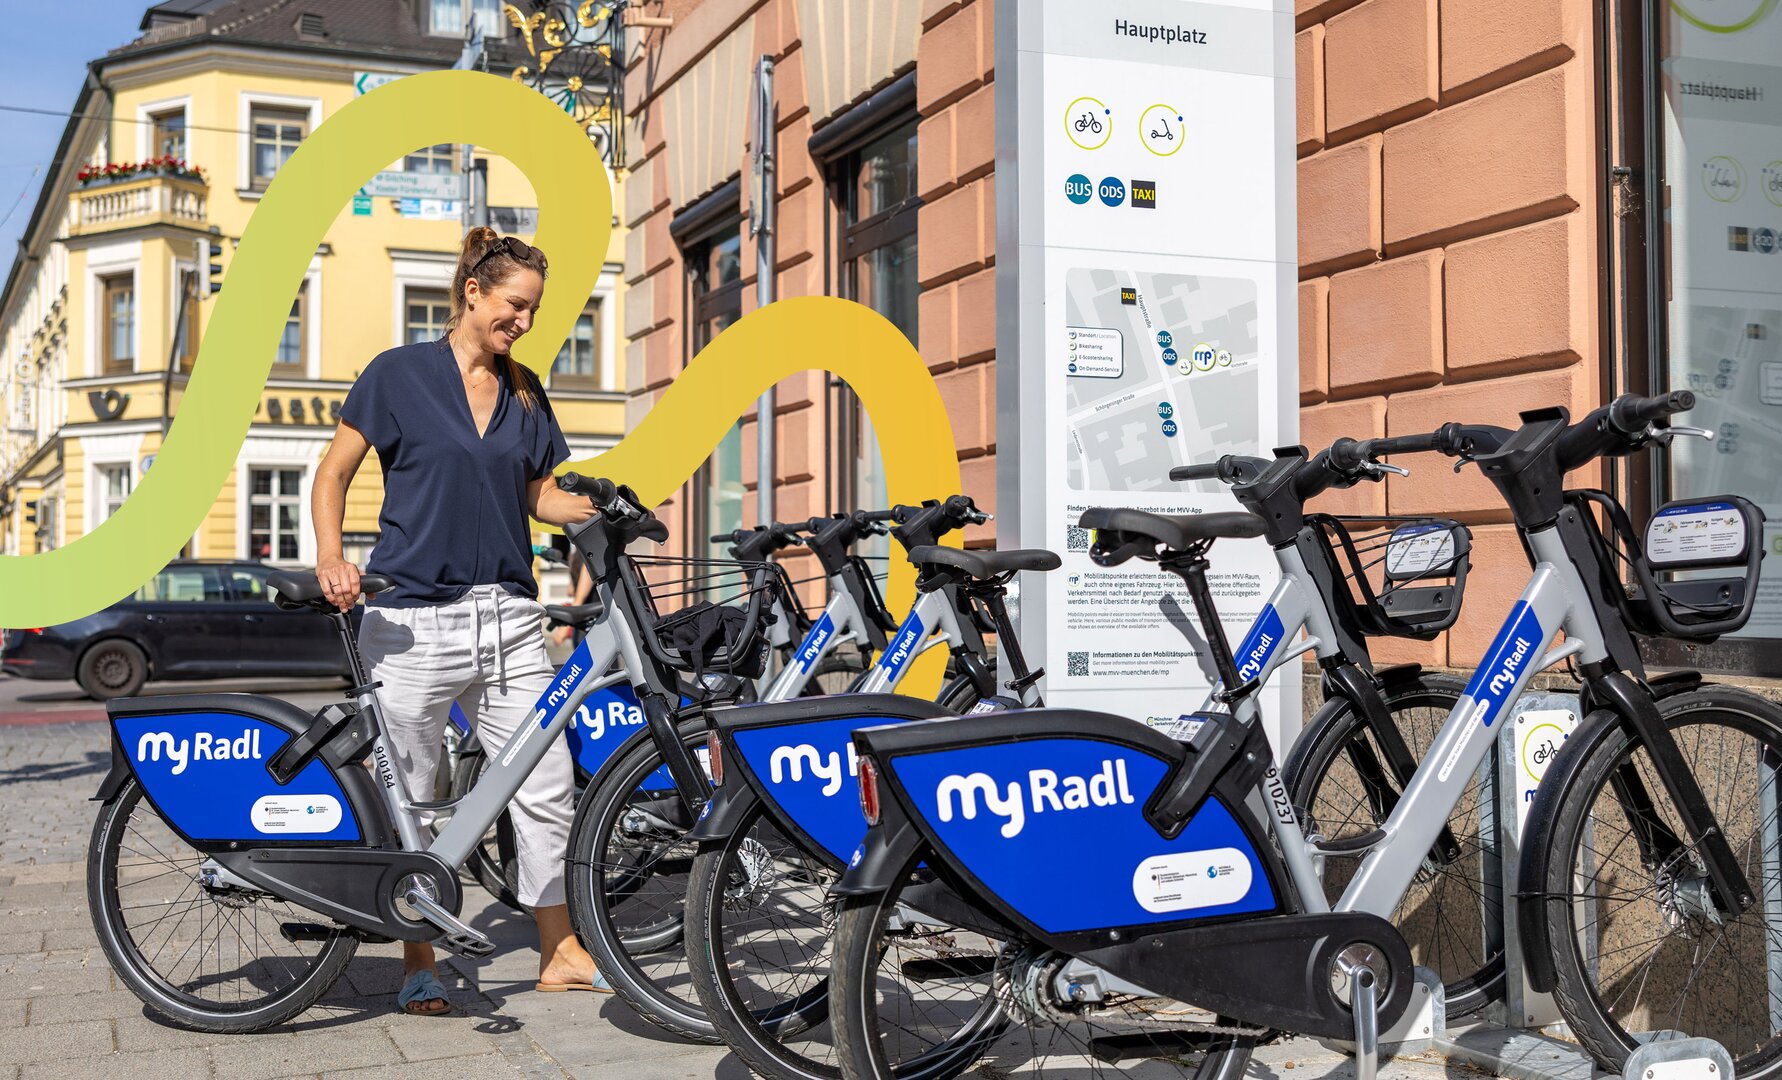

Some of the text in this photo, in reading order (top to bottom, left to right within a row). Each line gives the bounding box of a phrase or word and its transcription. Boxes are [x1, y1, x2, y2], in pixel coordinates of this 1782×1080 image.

[1115, 19, 1207, 45] Hauptplatz
[1065, 182, 1154, 201] BUS ODS TAXI
[1122, 292, 1135, 300] TAXI
[1138, 294, 1151, 328] Hauptstraße
[1157, 335, 1171, 343] BUS
[1158, 406, 1172, 414] BUS
[375, 746, 395, 788] 910184
[1265, 768, 1294, 825] 910237
